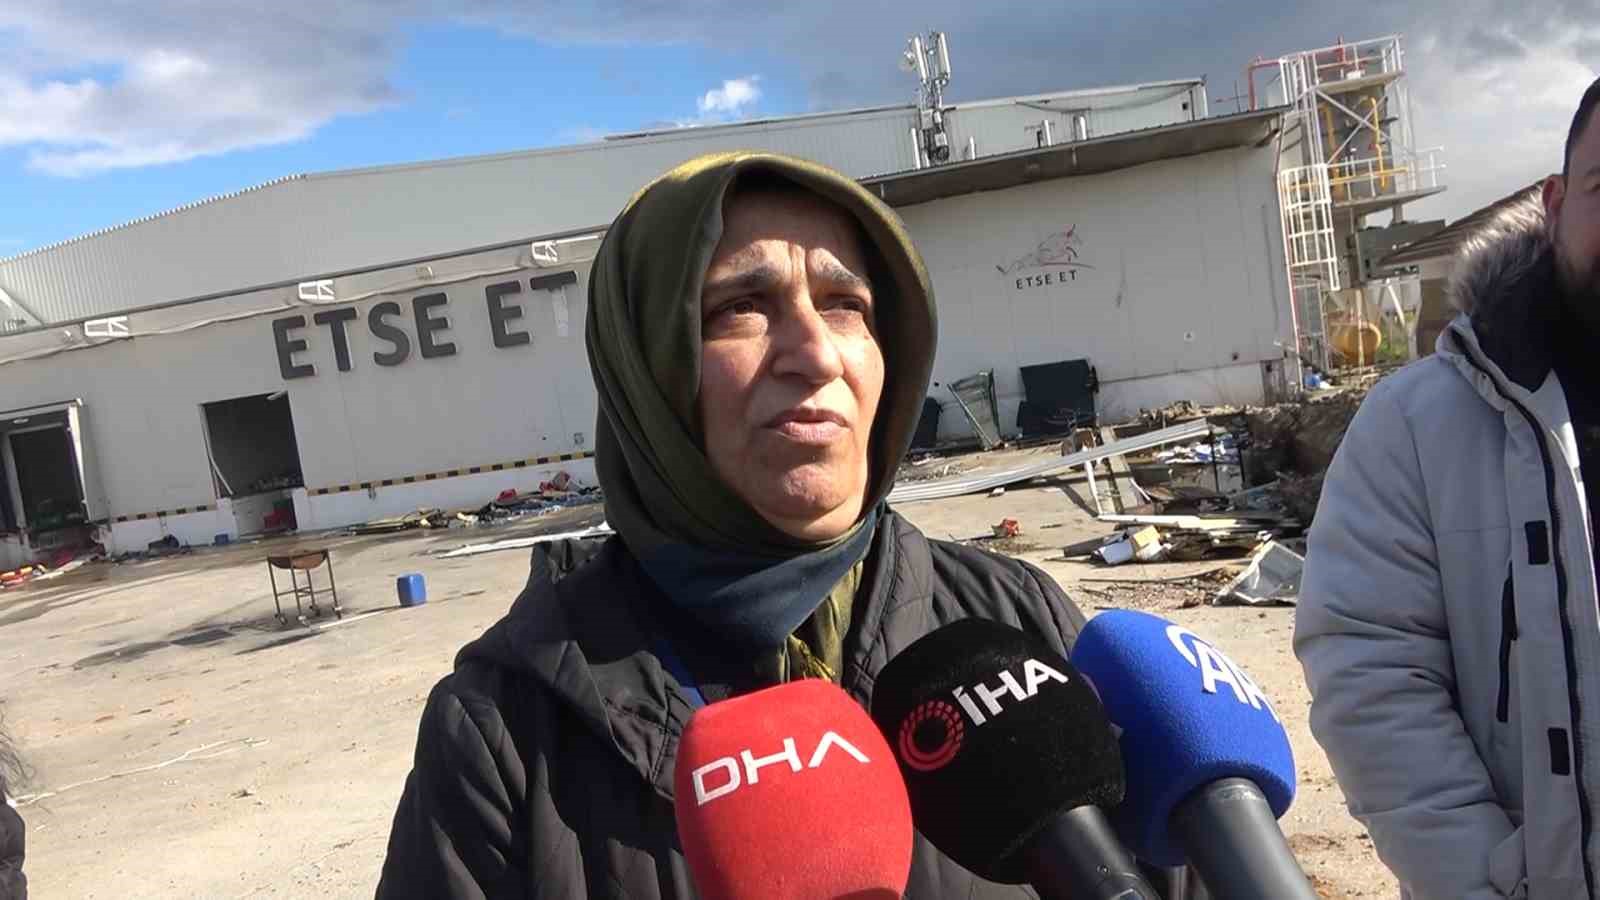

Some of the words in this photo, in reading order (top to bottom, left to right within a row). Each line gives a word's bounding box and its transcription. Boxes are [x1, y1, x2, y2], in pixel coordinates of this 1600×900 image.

[1015, 273, 1053, 290] ETSE
[1059, 270, 1076, 282] ET
[272, 292, 456, 380] ETSE
[952, 658, 1069, 726] İHA
[692, 731, 870, 806] DHA
